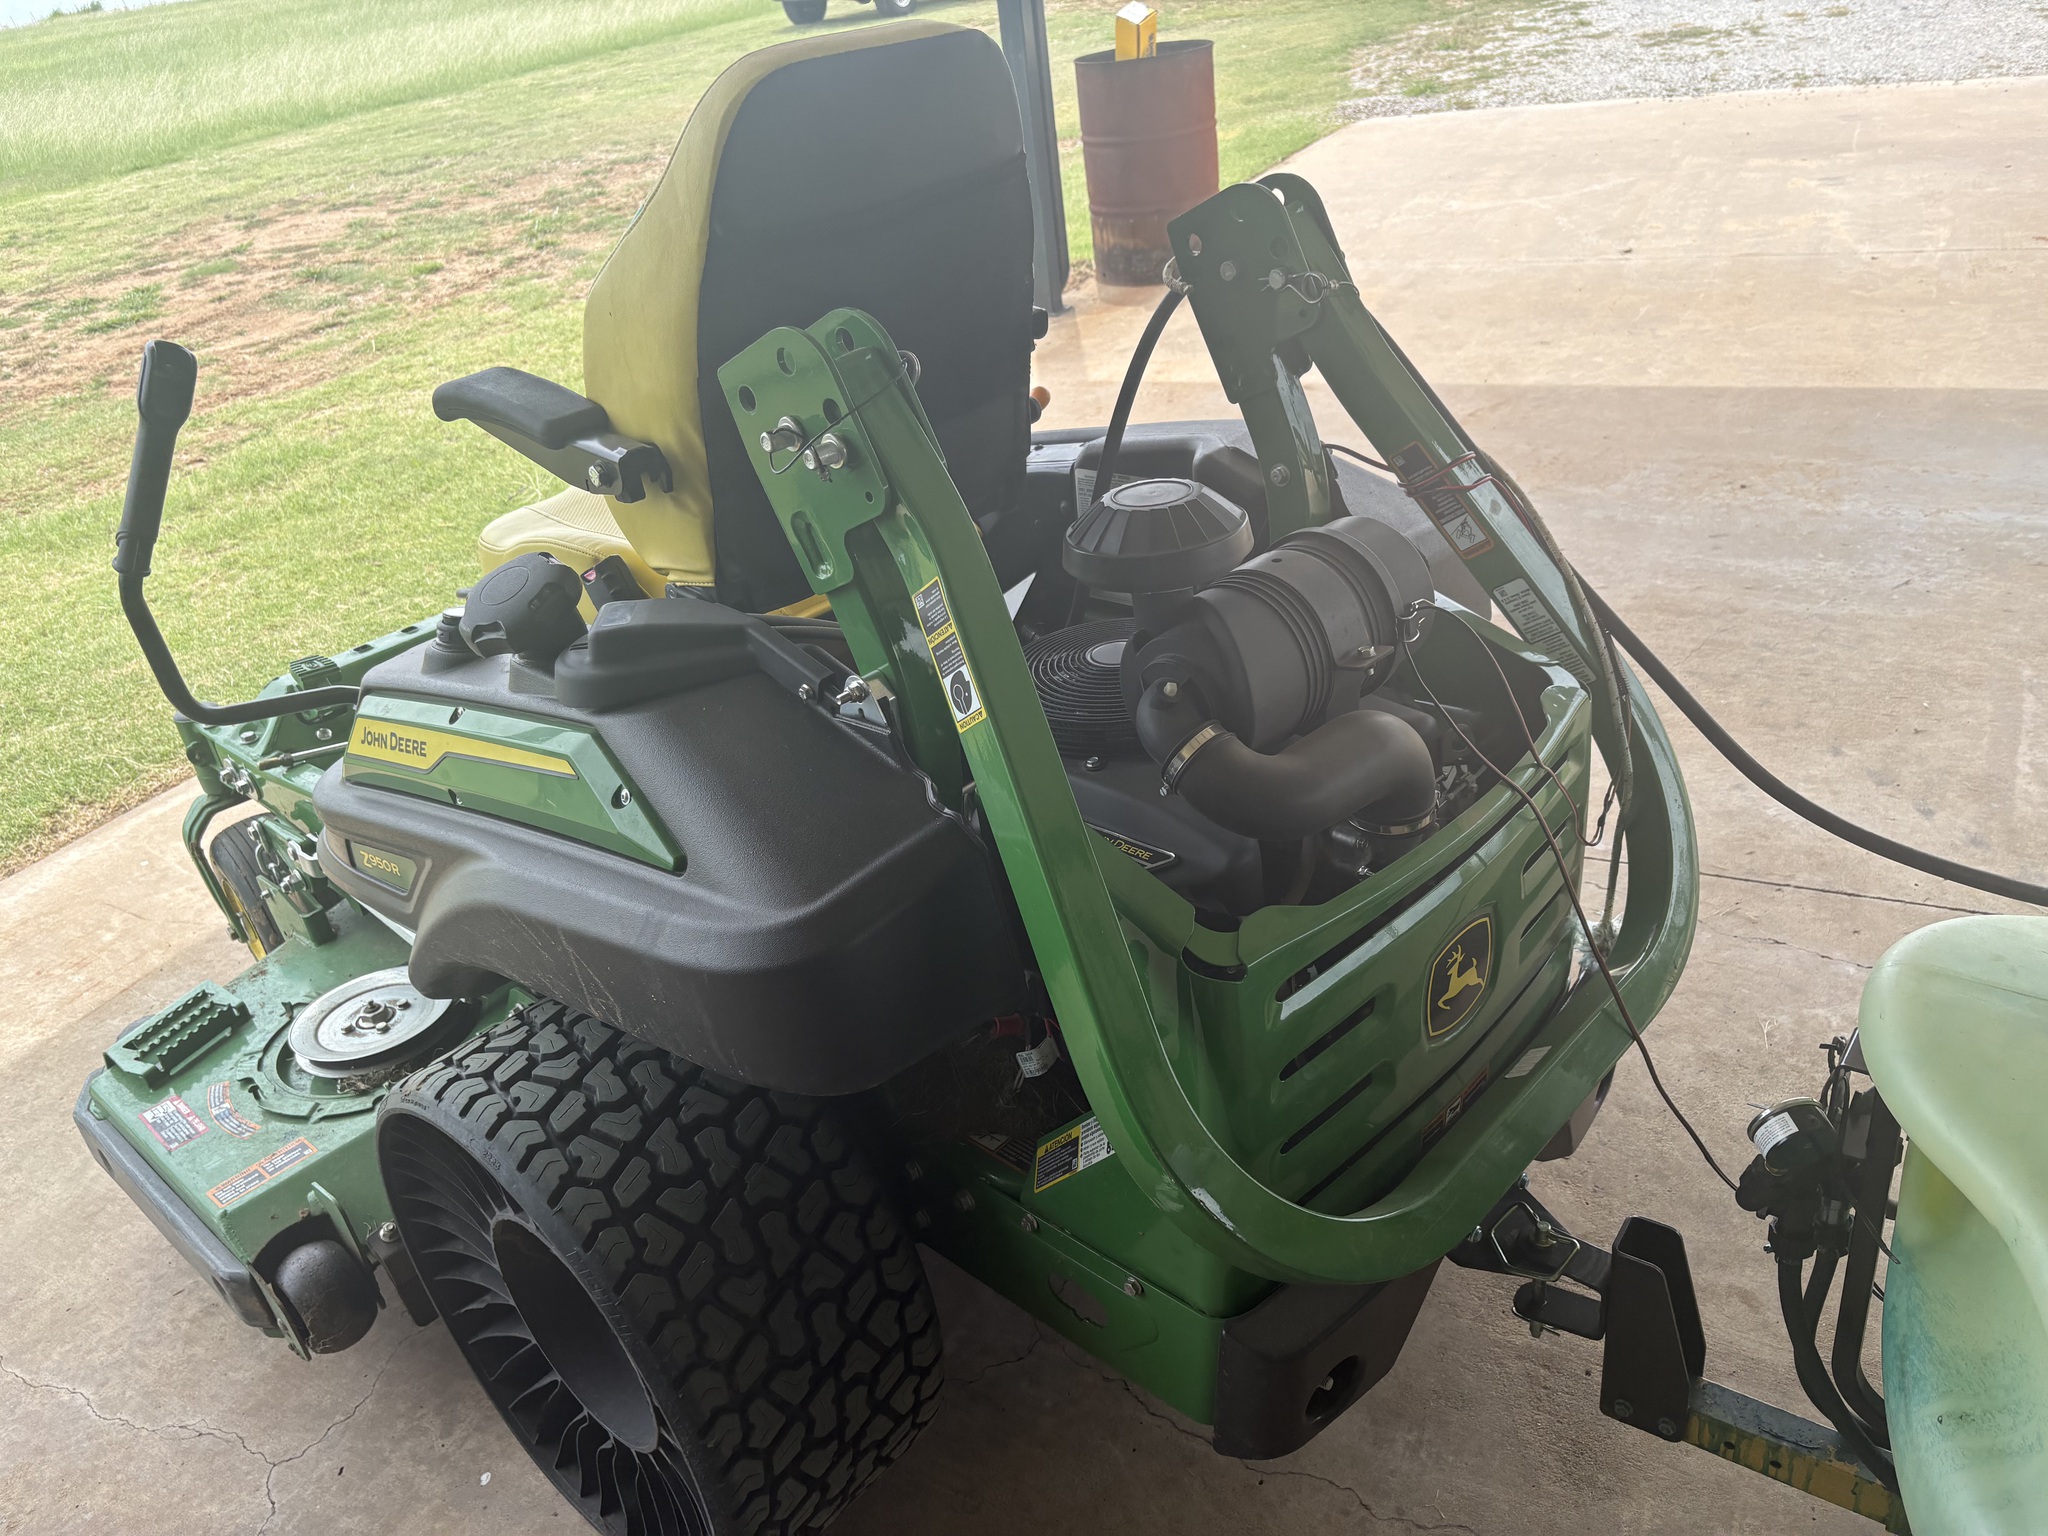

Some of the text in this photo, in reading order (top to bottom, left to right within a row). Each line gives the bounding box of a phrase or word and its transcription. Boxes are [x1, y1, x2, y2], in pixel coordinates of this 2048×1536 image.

[959, 712, 980, 731] CAUTION
[360, 726, 427, 757] JOHN DEERE
[1114, 839, 1153, 860] DEERE
[360, 850, 401, 877] Z950R
